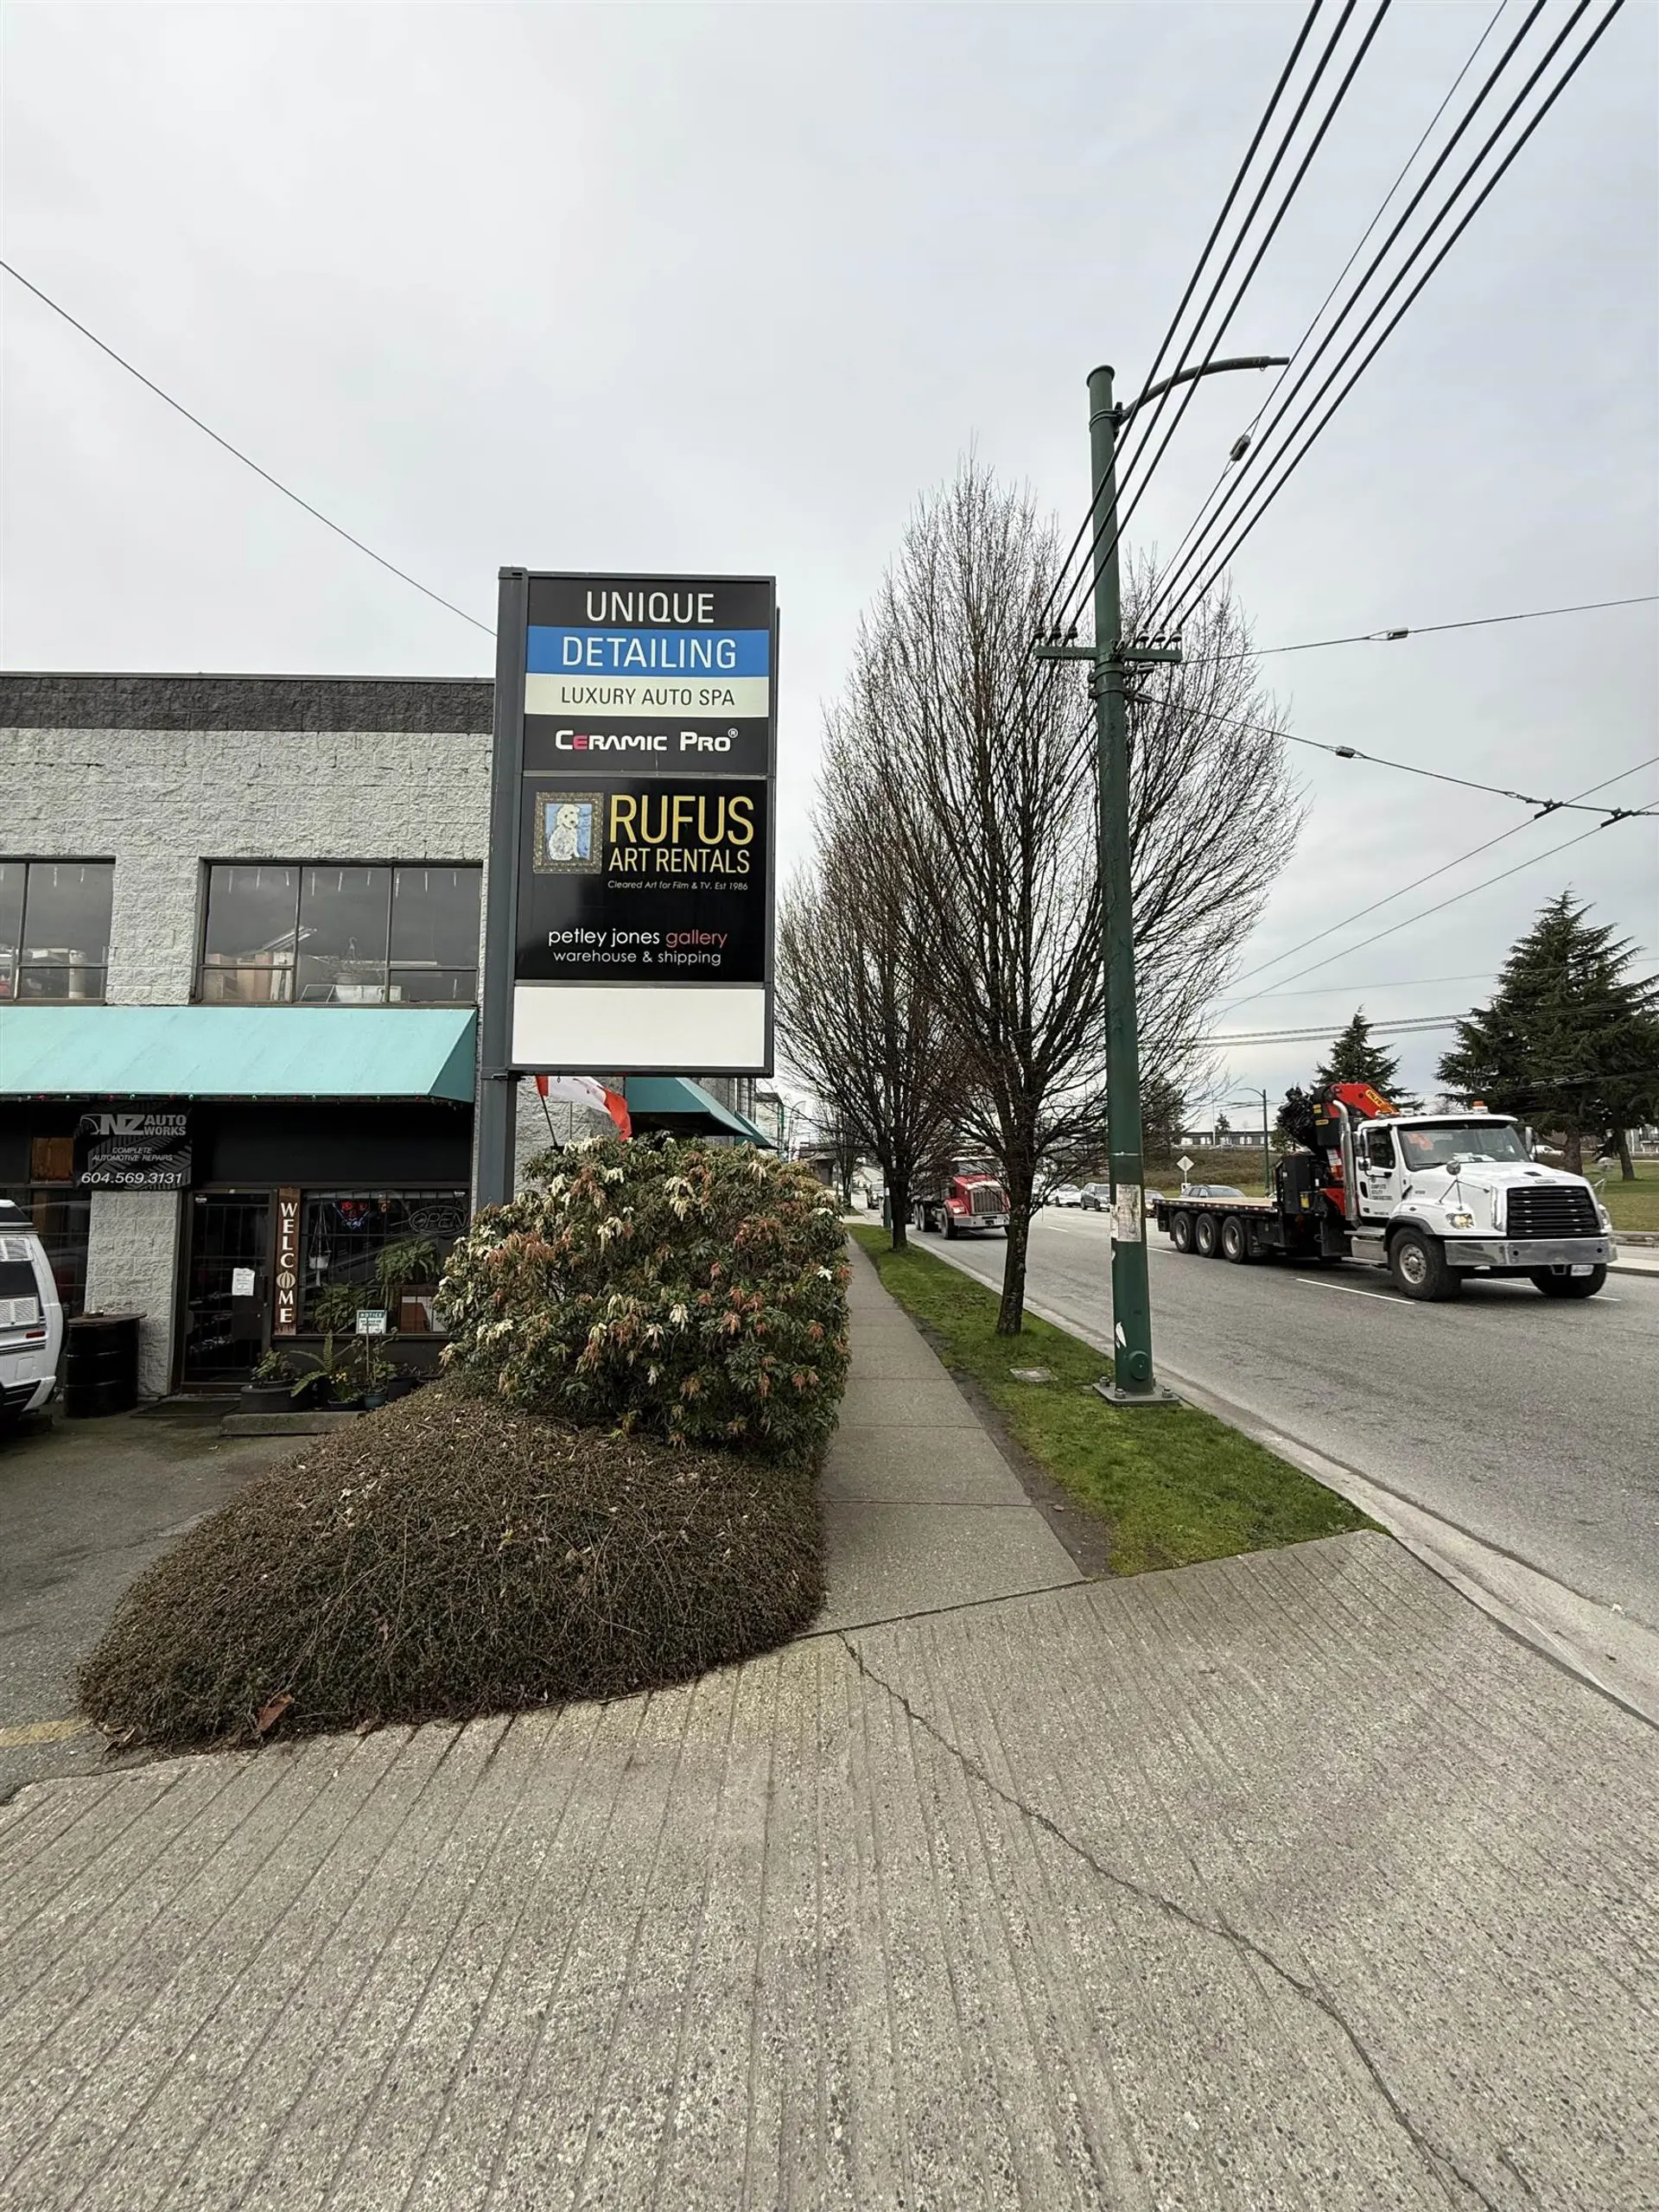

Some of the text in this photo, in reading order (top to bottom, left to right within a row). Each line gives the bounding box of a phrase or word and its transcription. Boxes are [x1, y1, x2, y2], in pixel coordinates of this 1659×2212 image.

[586, 591, 715, 624] UNIQUE
[563, 636, 736, 669] DETAILING
[562, 687, 734, 706] LUXURY AUTO SPA
[609, 794, 754, 845] RUFUS
[608, 848, 750, 874] ART RENTALS
[607, 880, 643, 889] Cleared
[645, 880, 658, 889] Art
[659, 880, 671, 889] for
[672, 881, 689, 890] Film
[729, 882, 748, 891] 1986
[548, 928, 728, 949] petley jones gallery
[553, 950, 721, 966] warehouse & shipping
[99, 1114, 187, 1135] NZ AUTO
[143, 1126, 187, 1136] WORKS
[81, 1172, 182, 1184] 604.569.3131
[412, 1212, 467, 1228] OPEN
